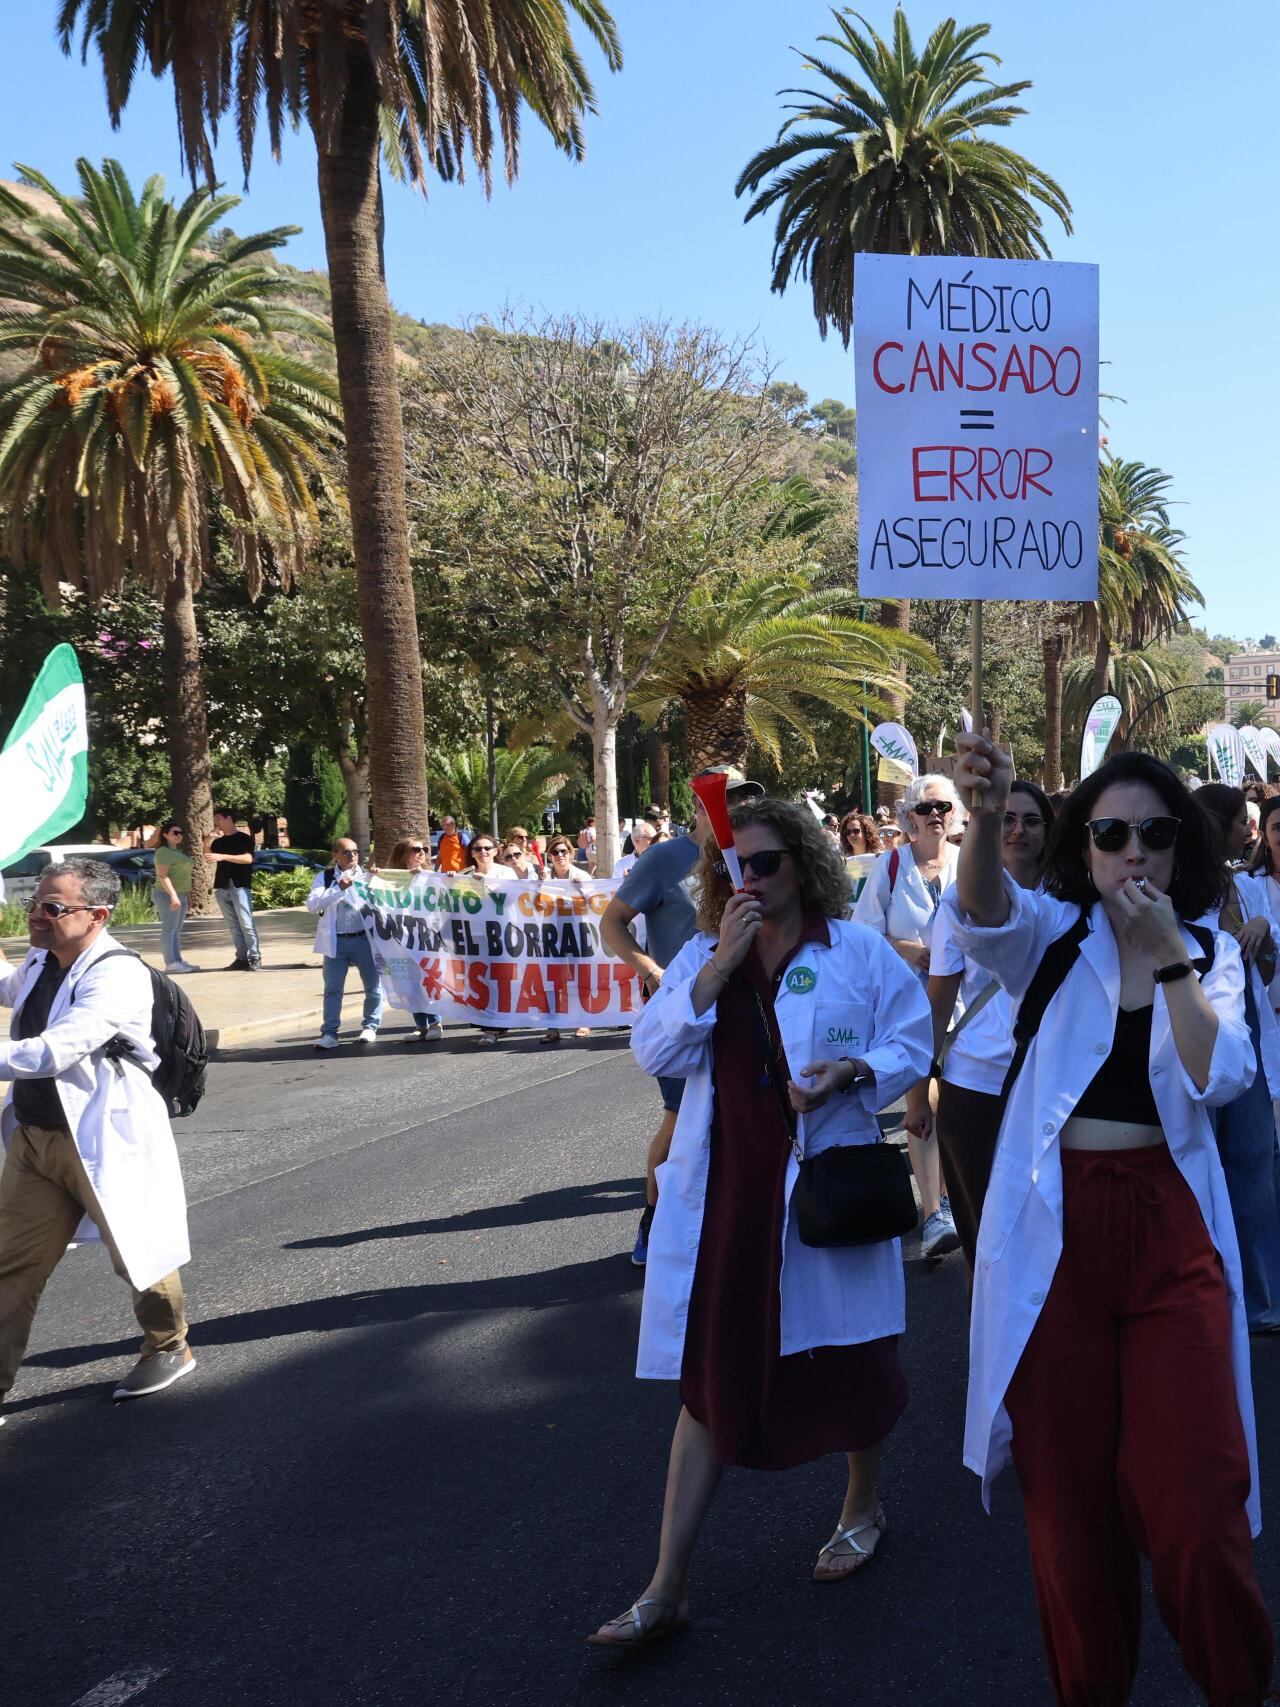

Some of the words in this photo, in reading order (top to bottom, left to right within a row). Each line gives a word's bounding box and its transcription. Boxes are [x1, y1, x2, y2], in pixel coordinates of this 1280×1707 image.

[907, 270, 1051, 334] MÉDICO
[872, 340, 1082, 397] CANSADO
[912, 445, 1054, 502] ERROR
[869, 516, 1084, 571] ASEGURADO
[489, 892, 507, 916] Y
[518, 890, 616, 917] COLEG
[451, 919, 480, 956] EL
[485, 921, 637, 958] BORRAD
[827, 1026, 859, 1046] SMA
